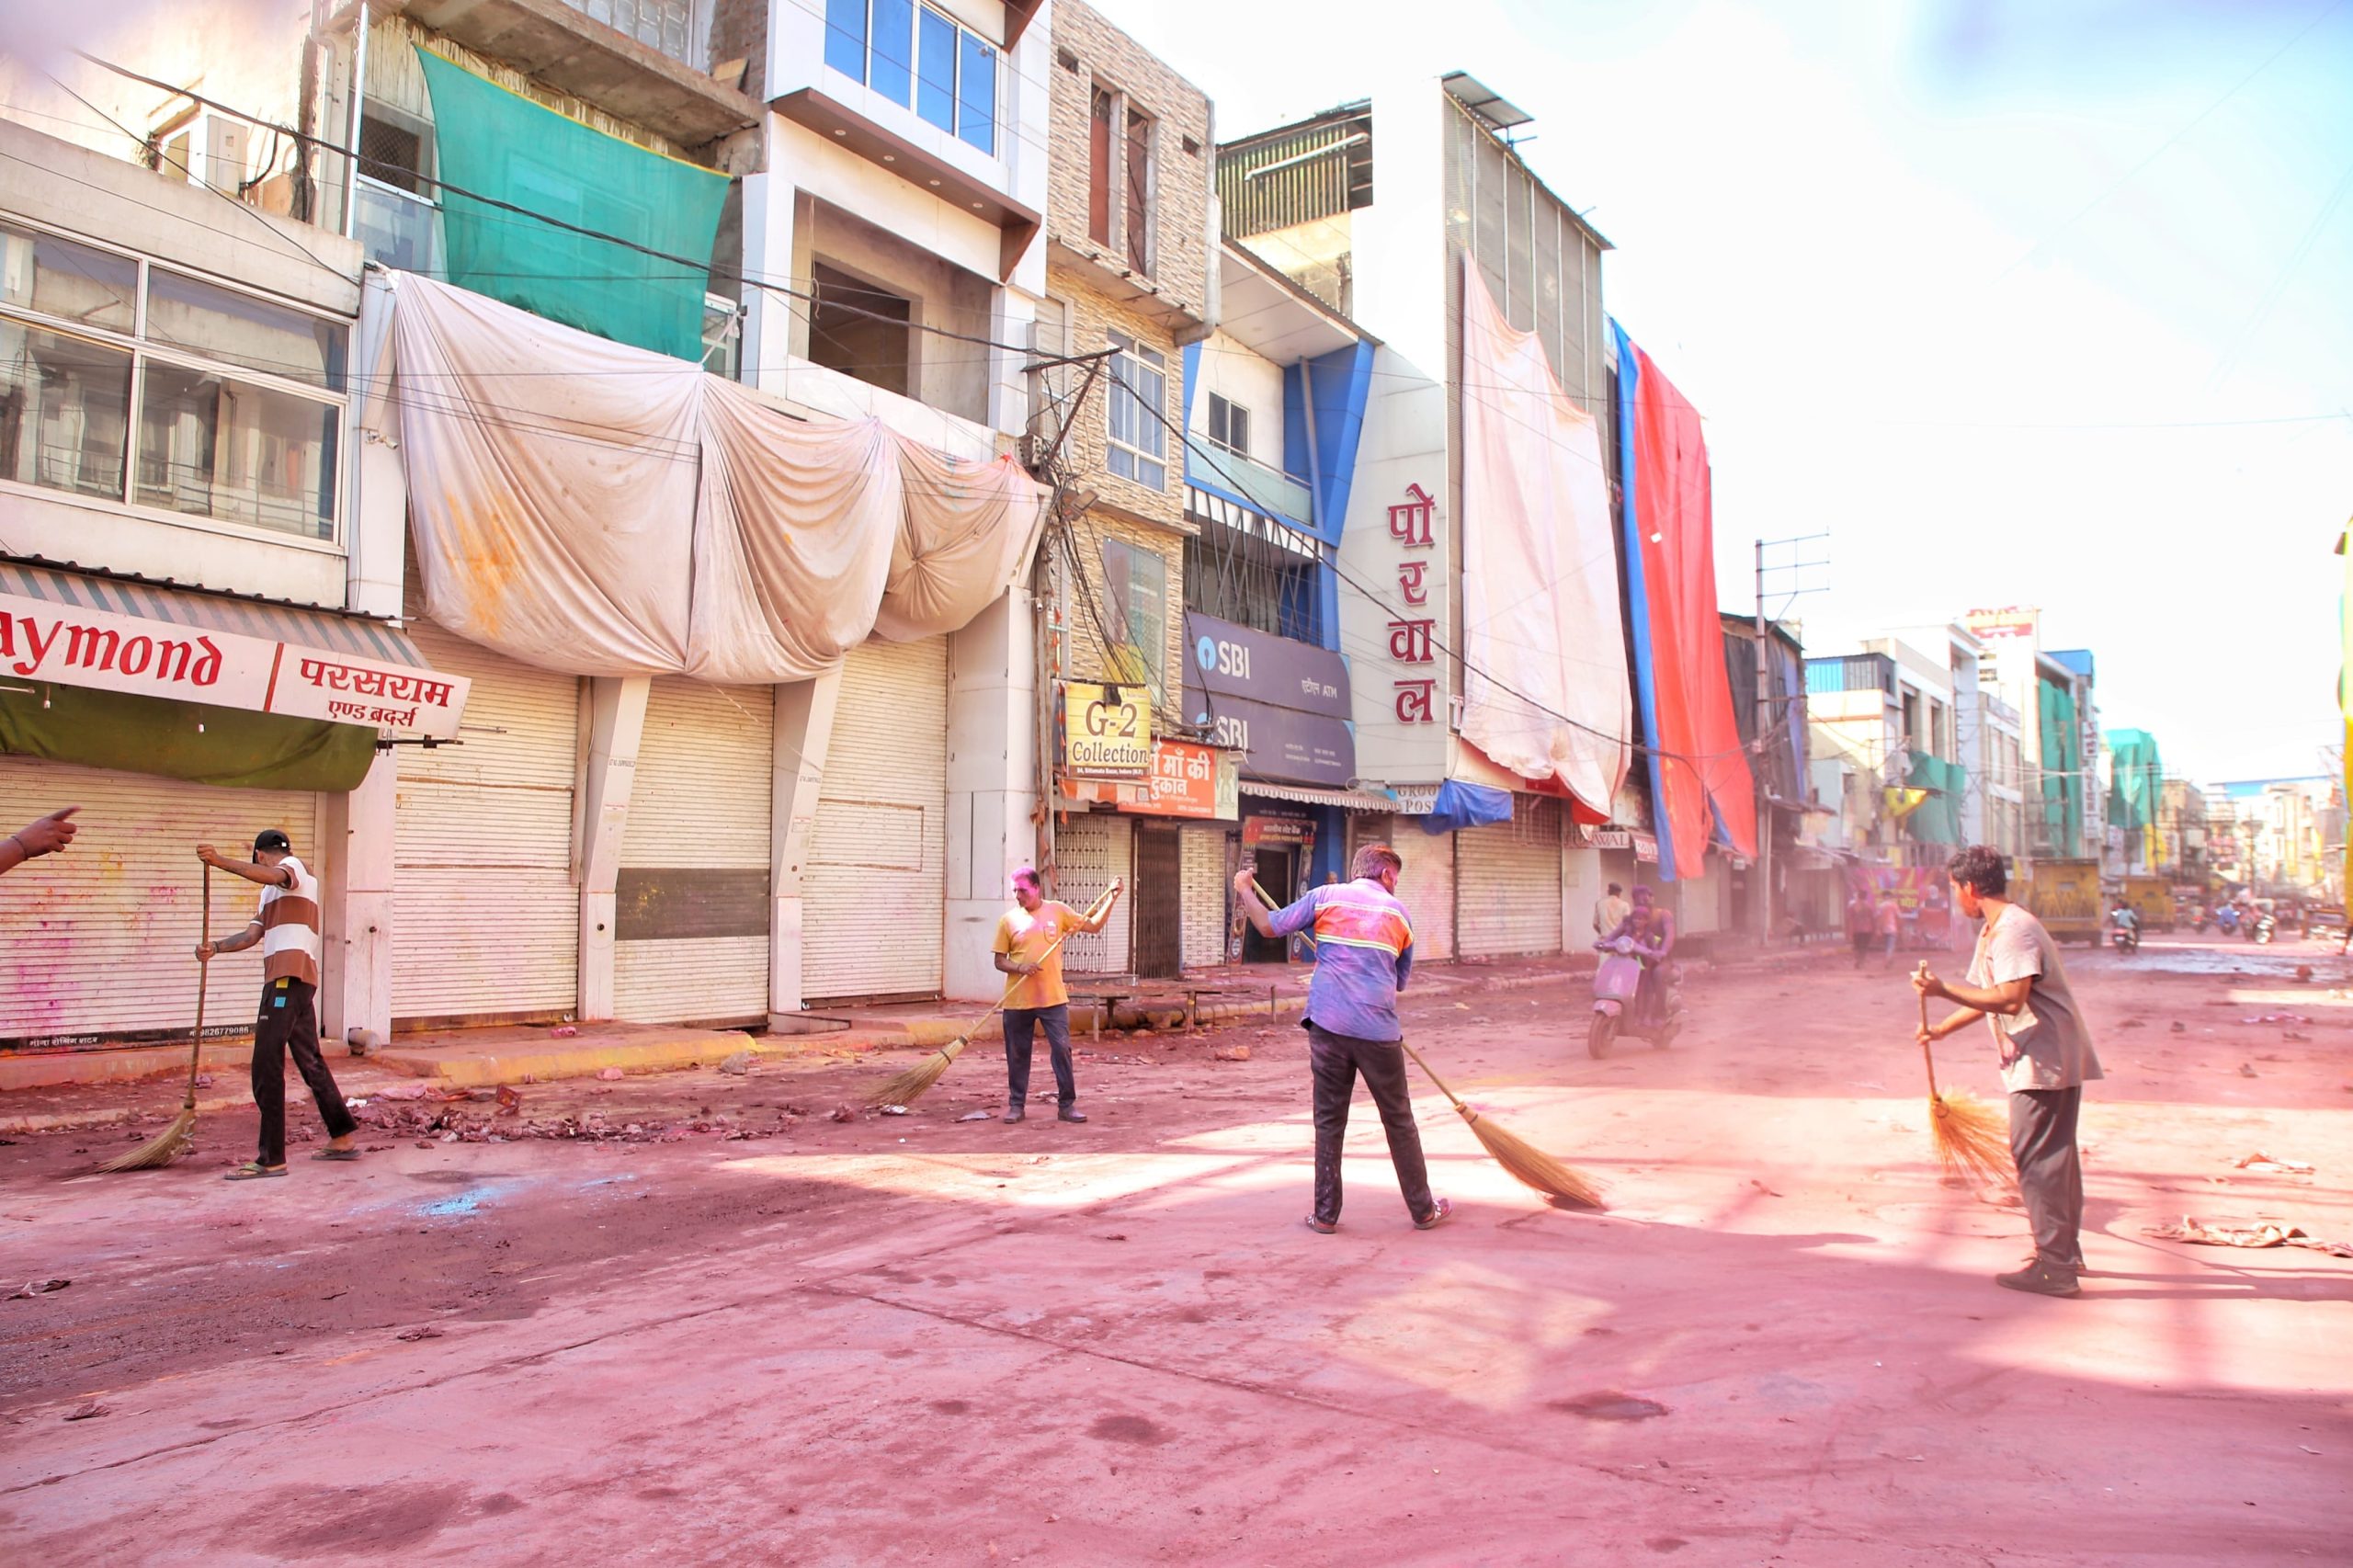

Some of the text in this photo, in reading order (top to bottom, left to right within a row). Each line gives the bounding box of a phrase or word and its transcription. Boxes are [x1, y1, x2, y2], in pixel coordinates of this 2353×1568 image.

[1387, 483, 1437, 724] पोरवाल
[1218, 640, 1250, 680] SBI
[300, 658, 455, 708] परसराम
[1302, 676, 1337, 699] एटीएम ATM
[328, 699, 419, 727] एण्ड ब्रदर्स
[1086, 699, 1138, 739] G-2
[1217, 715, 1249, 750] SBI
[1073, 741, 1148, 765] Collection
[1187, 750, 1211, 781] की
[1150, 776, 1188, 800] दुकान
